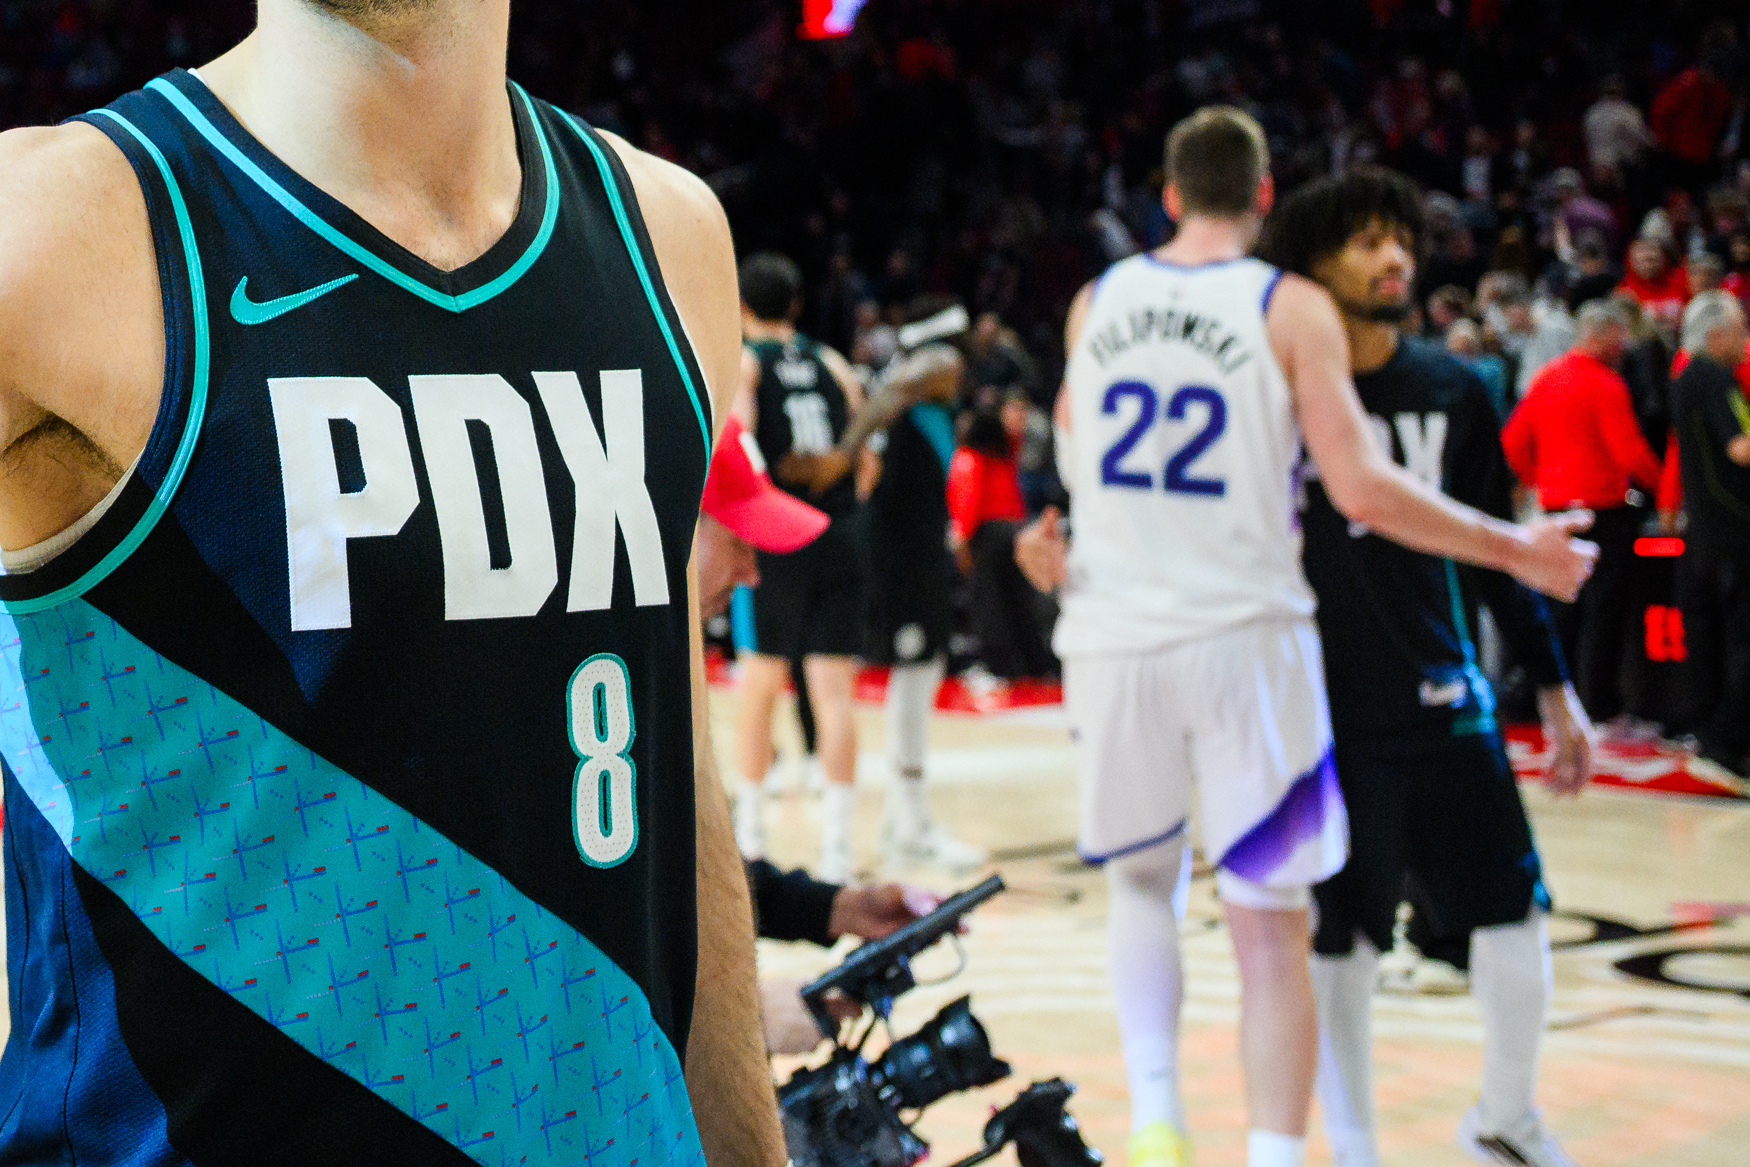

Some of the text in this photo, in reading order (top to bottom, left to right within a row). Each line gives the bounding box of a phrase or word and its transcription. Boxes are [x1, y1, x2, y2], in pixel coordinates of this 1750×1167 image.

[267, 368, 671, 632] PDX
[1100, 380, 1228, 499] 22
[566, 652, 638, 869] 8
